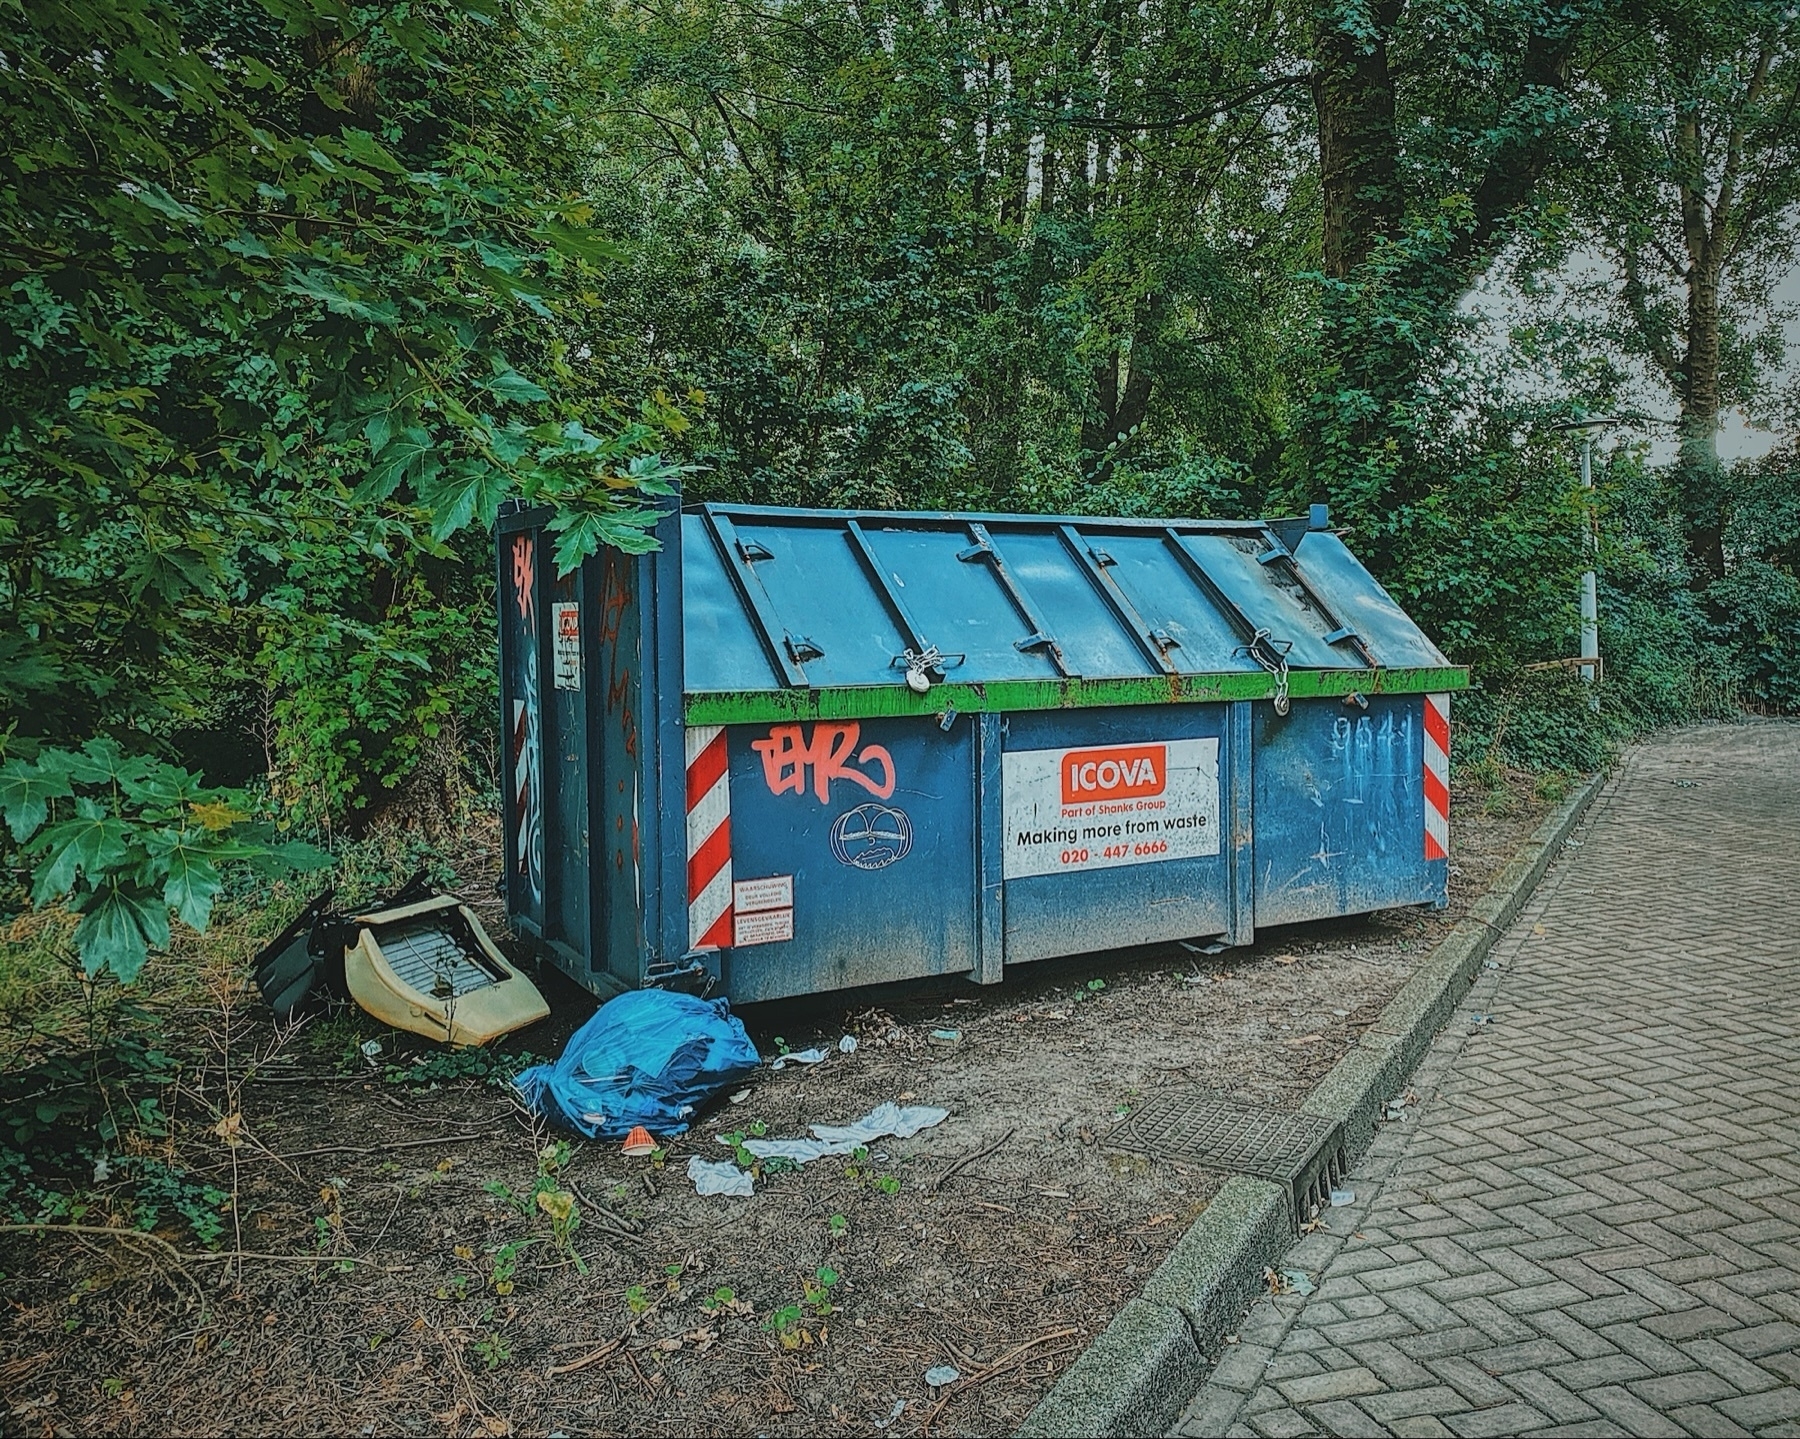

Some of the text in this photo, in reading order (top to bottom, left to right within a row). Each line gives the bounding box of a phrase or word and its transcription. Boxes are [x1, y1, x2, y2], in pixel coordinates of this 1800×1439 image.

[1071, 758, 1158, 792] ICOVA
[1062, 799, 1166, 818] Part of Shanks Group
[1017, 814, 1207, 846] Making more from waste
[1061, 848, 1089, 865] 020
[1103, 844, 1130, 859] 447
[1134, 839, 1168, 857] 6666
